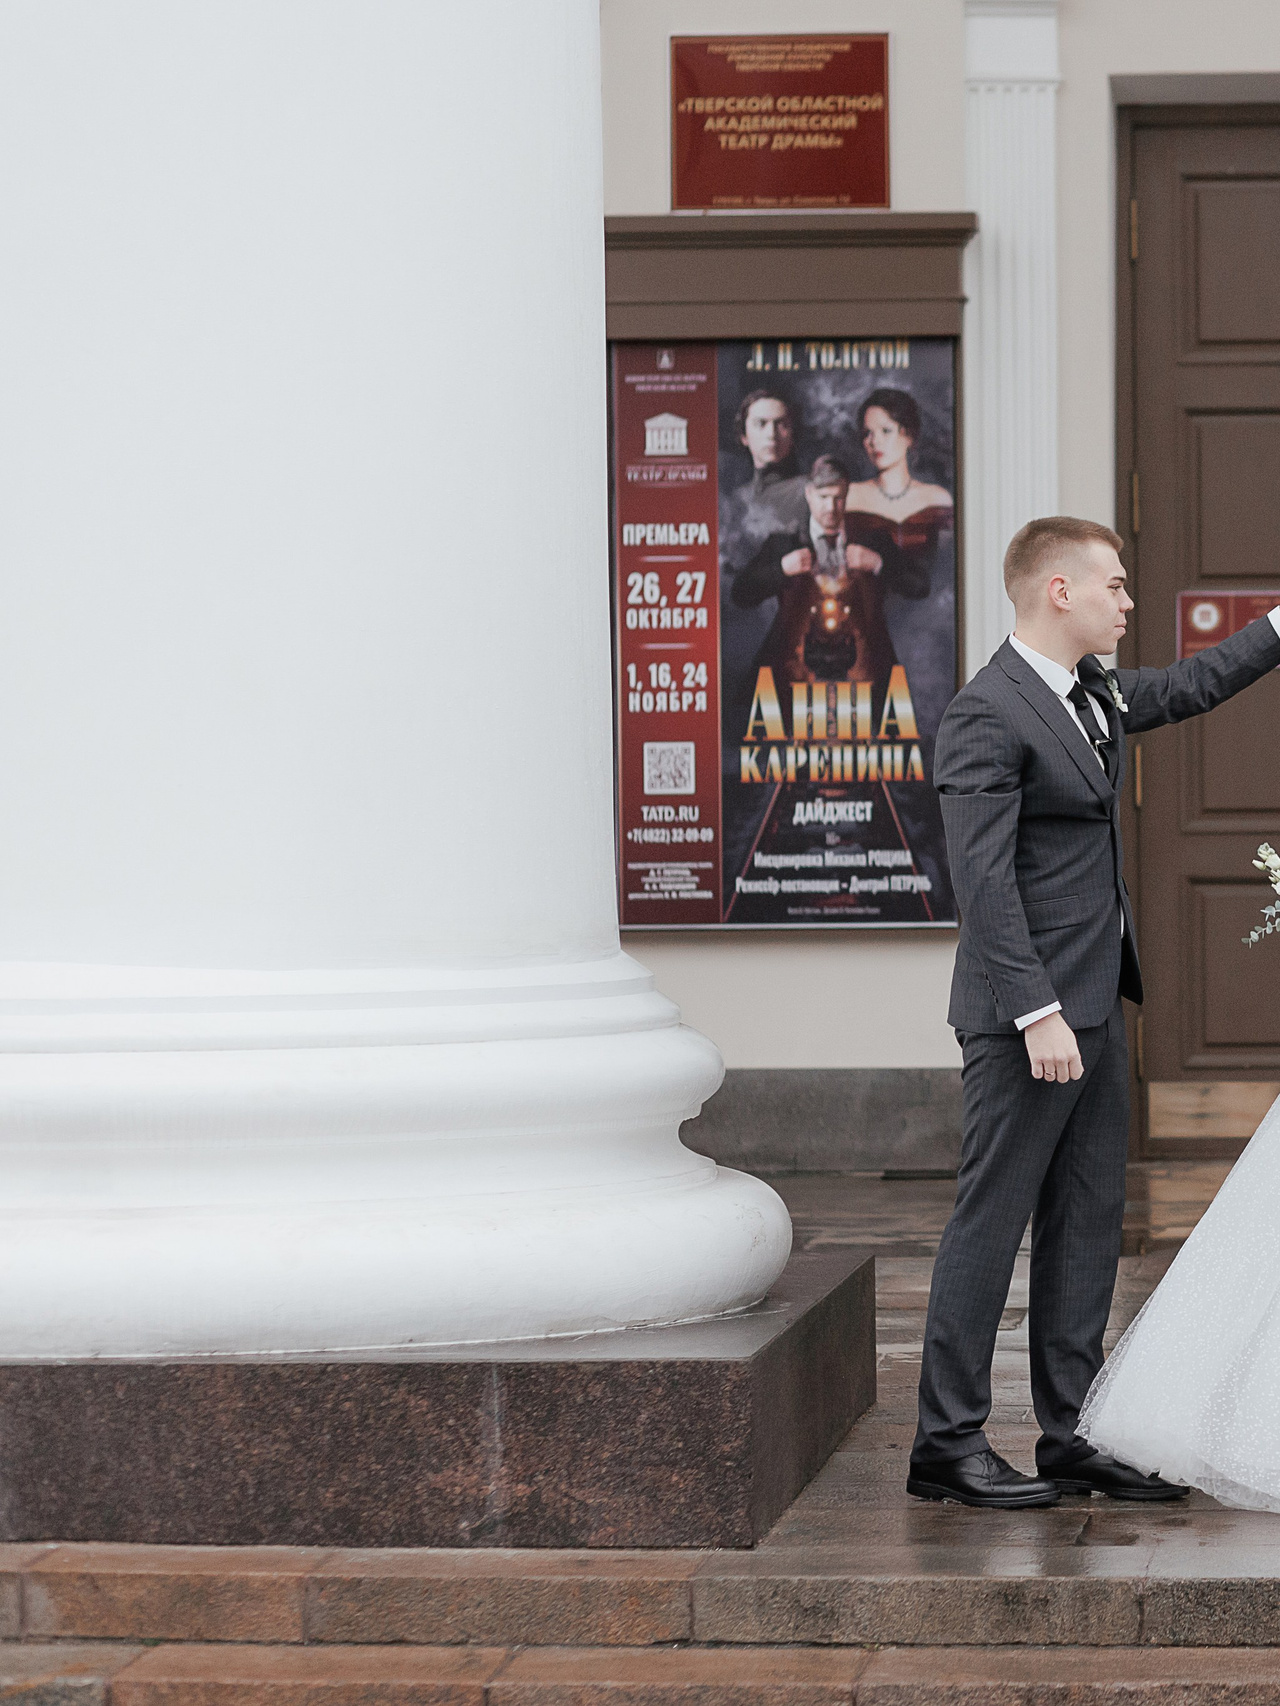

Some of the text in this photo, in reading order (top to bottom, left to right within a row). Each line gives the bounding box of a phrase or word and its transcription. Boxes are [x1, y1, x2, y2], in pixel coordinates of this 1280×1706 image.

[776, 92, 884, 113] ОБЛАСТНОЙ
[704, 111, 858, 132] АКАДЕМИЧЕСКИЙ
[719, 133, 769, 150] ТЕАТР
[805, 339, 909, 371] ТОЛСТОЙ
[622, 523, 710, 546] ПРЕМЬЕРА
[627, 571, 707, 608] 26, 27
[625, 607, 708, 630] ОКТЯБРЯ
[627, 662, 708, 692] 1, 16, 24
[628, 691, 708, 713] НОЯБРЯ
[743, 664, 921, 741] АННА
[740, 744, 925, 783] КАРЕНИНА
[641, 805, 700, 822] TATD.RU
[792, 797, 874, 825] ДАЙДЖЕСТ
